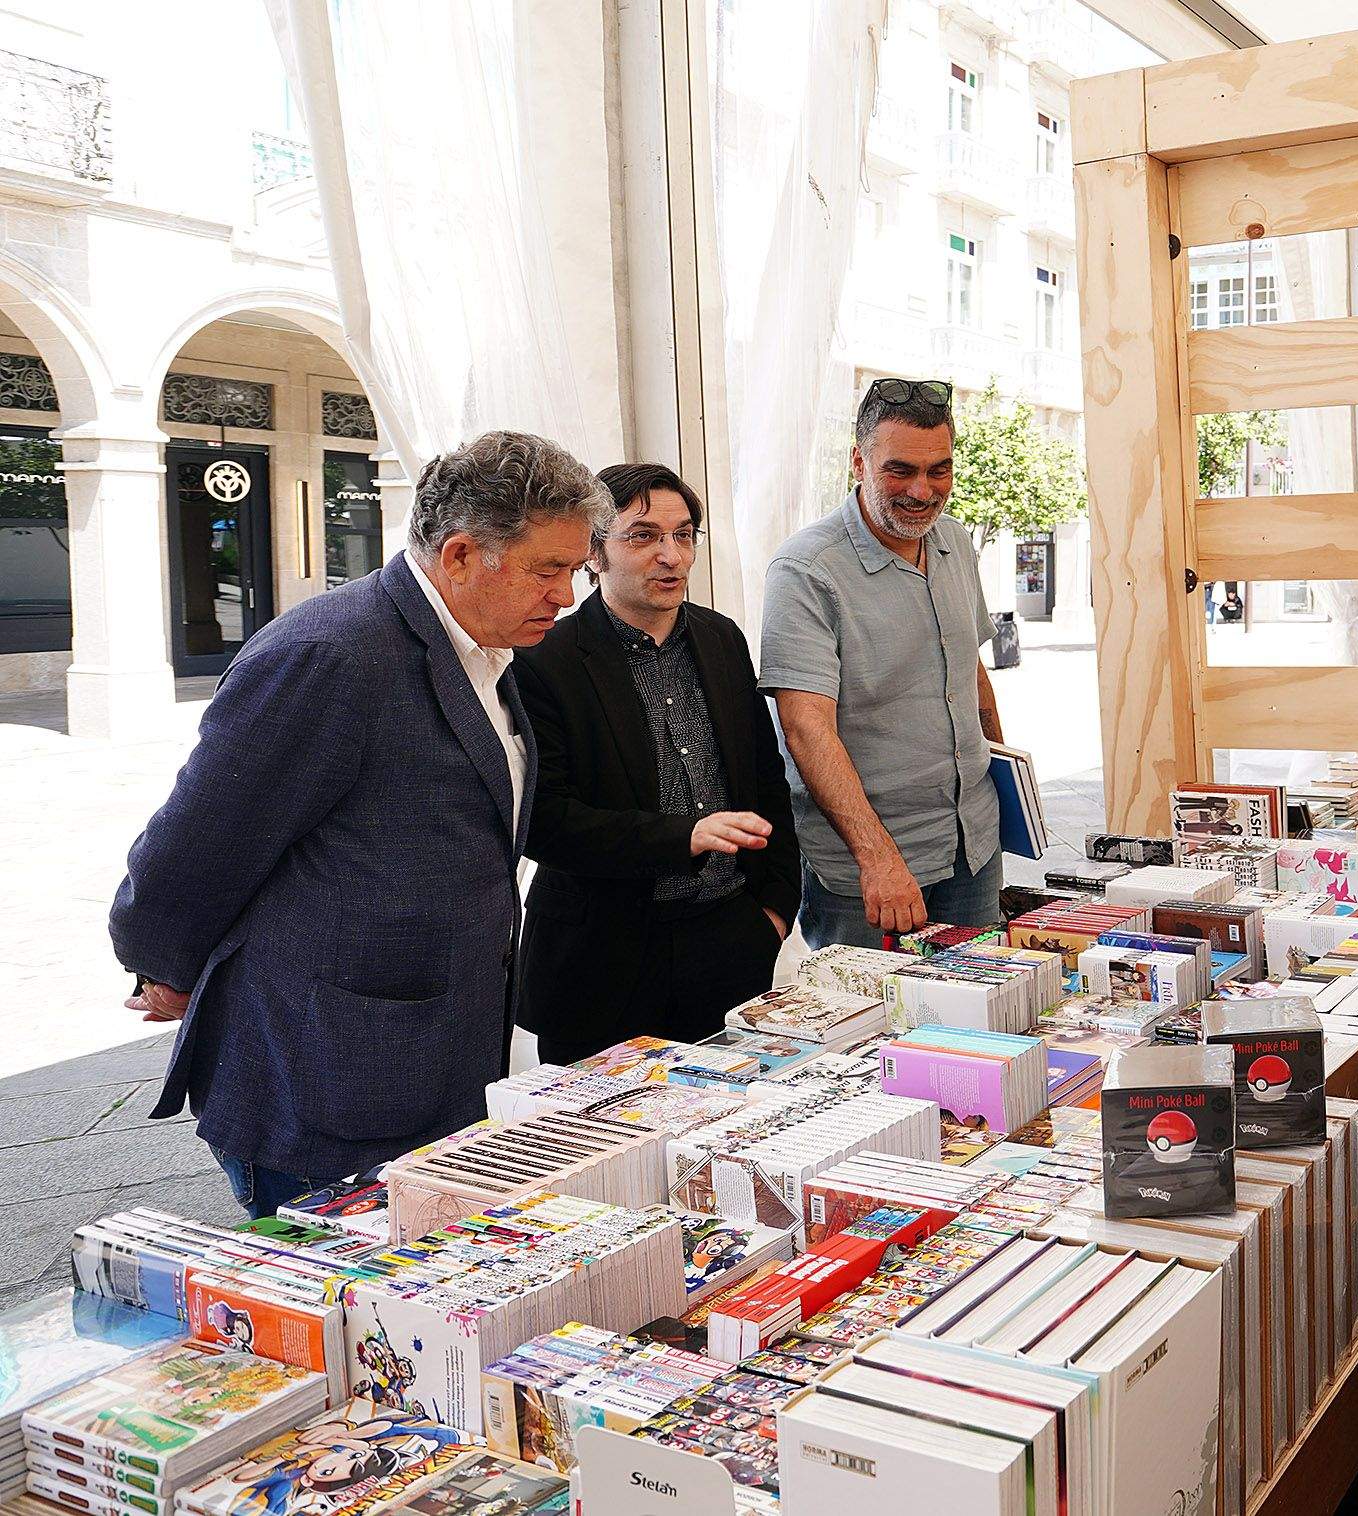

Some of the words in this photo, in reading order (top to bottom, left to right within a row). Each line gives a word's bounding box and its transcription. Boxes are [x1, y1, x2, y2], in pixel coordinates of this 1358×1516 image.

[337, 491, 382, 501] mann
[1233, 1042, 1253, 1054] Mini
[1255, 1041, 1278, 1053] Poké
[1280, 1039, 1300, 1052] Ball
[1129, 1095, 1154, 1109] Mini
[1156, 1094, 1182, 1108] Poké
[1184, 1093, 1206, 1107] Ball
